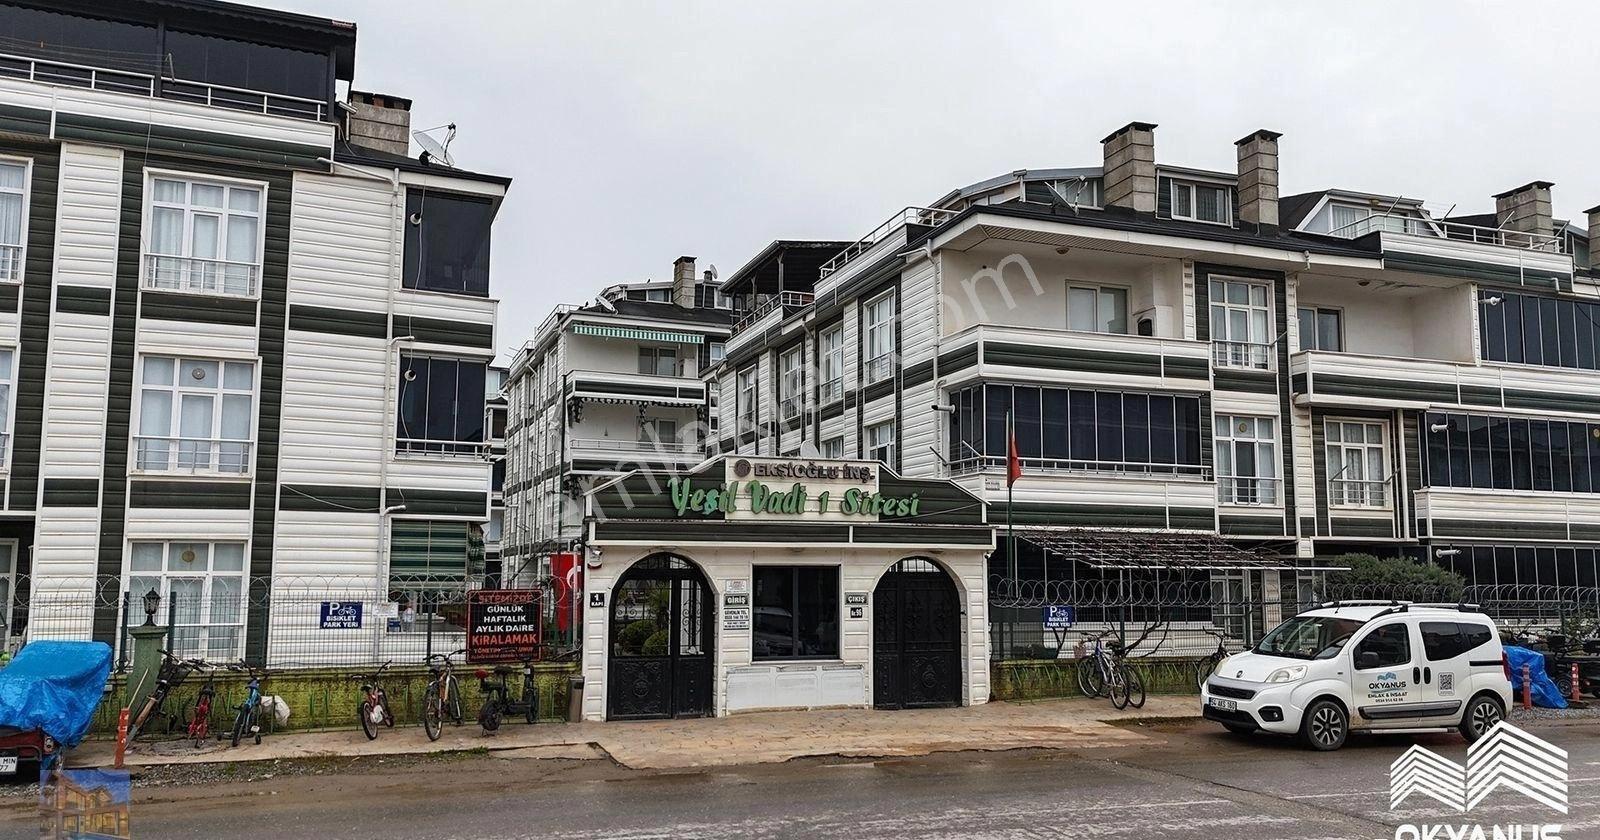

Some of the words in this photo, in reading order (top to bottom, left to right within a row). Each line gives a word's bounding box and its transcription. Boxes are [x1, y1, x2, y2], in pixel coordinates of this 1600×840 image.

[667, 478, 738, 516] Yeşil
[744, 480, 807, 514] Vadi
[818, 491, 829, 514] 1
[840, 488, 920, 516] Sitesi
[487, 604, 524, 613] GÜNLÜK
[483, 615, 527, 623] HAFTALIK
[475, 625, 504, 633] AYLIK
[1369, 681, 1407, 689] OKYANUS
